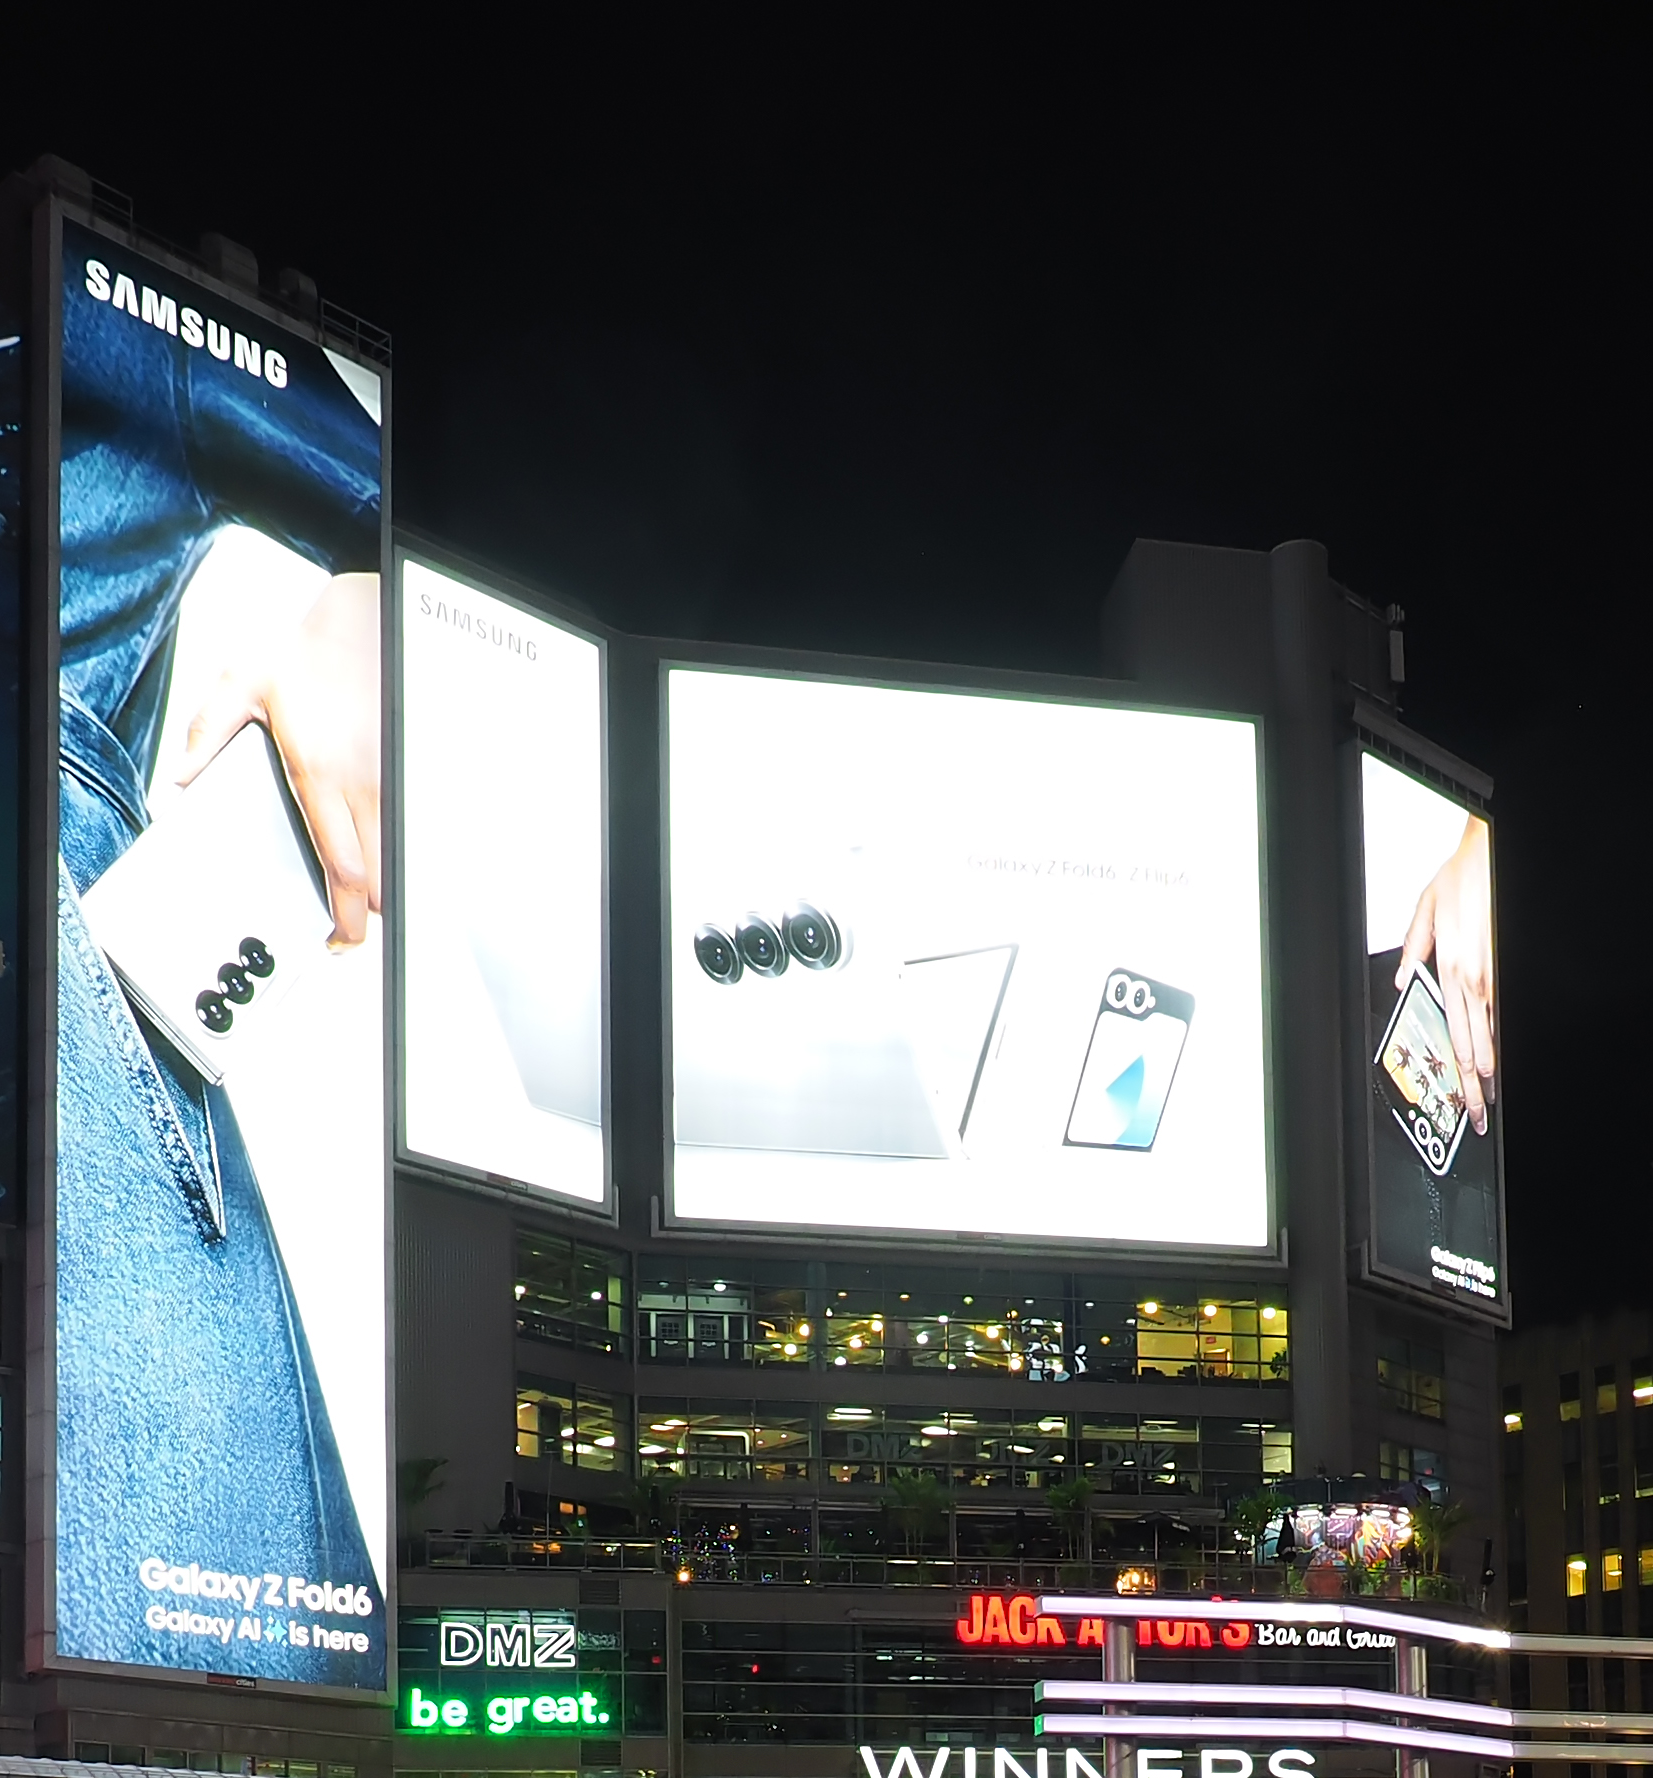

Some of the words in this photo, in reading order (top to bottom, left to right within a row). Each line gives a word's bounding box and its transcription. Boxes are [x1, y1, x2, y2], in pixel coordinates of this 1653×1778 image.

[84, 257, 289, 390] SAMSUNG
[420, 593, 537, 662] SAMSUNG
[139, 1557, 261, 1611] Galaxy
[263, 1573, 284, 1607] Z
[287, 1576, 373, 1617] Fold6
[145, 1604, 235, 1645] Galaxy
[237, 1616, 261, 1642] AI
[289, 1620, 309, 1647] is
[313, 1624, 370, 1653] here
[440, 1621, 576, 1668] DMZ
[410, 1688, 468, 1729] be
[485, 1688, 610, 1735] great.
